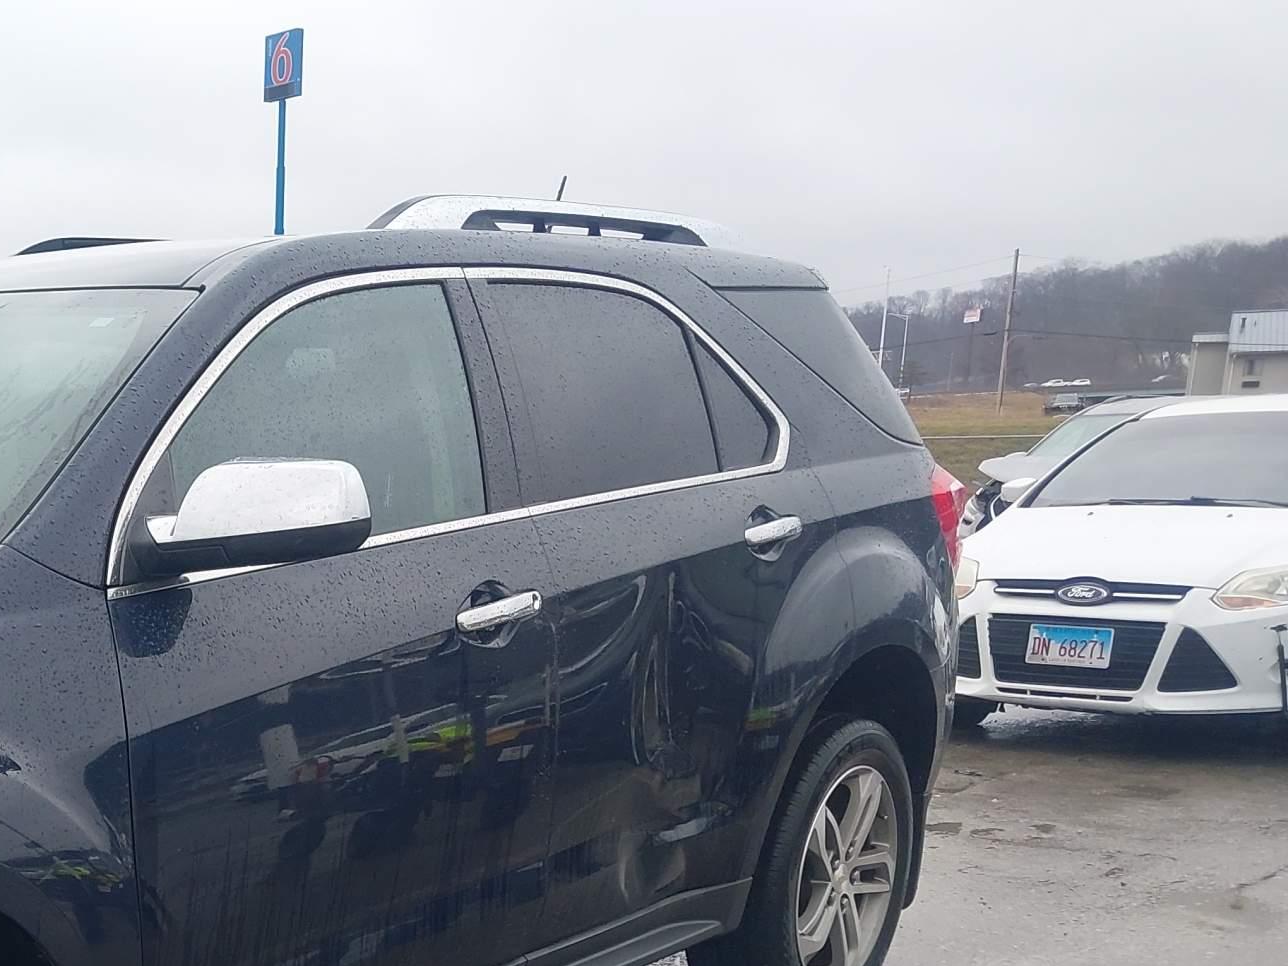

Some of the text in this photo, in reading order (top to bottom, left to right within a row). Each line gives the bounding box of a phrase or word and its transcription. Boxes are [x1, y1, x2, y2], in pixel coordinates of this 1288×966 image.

[271, 32, 293, 86] 6
[1067, 585, 1096, 598] Ford
[1031, 637, 1105, 660] DN 68271
